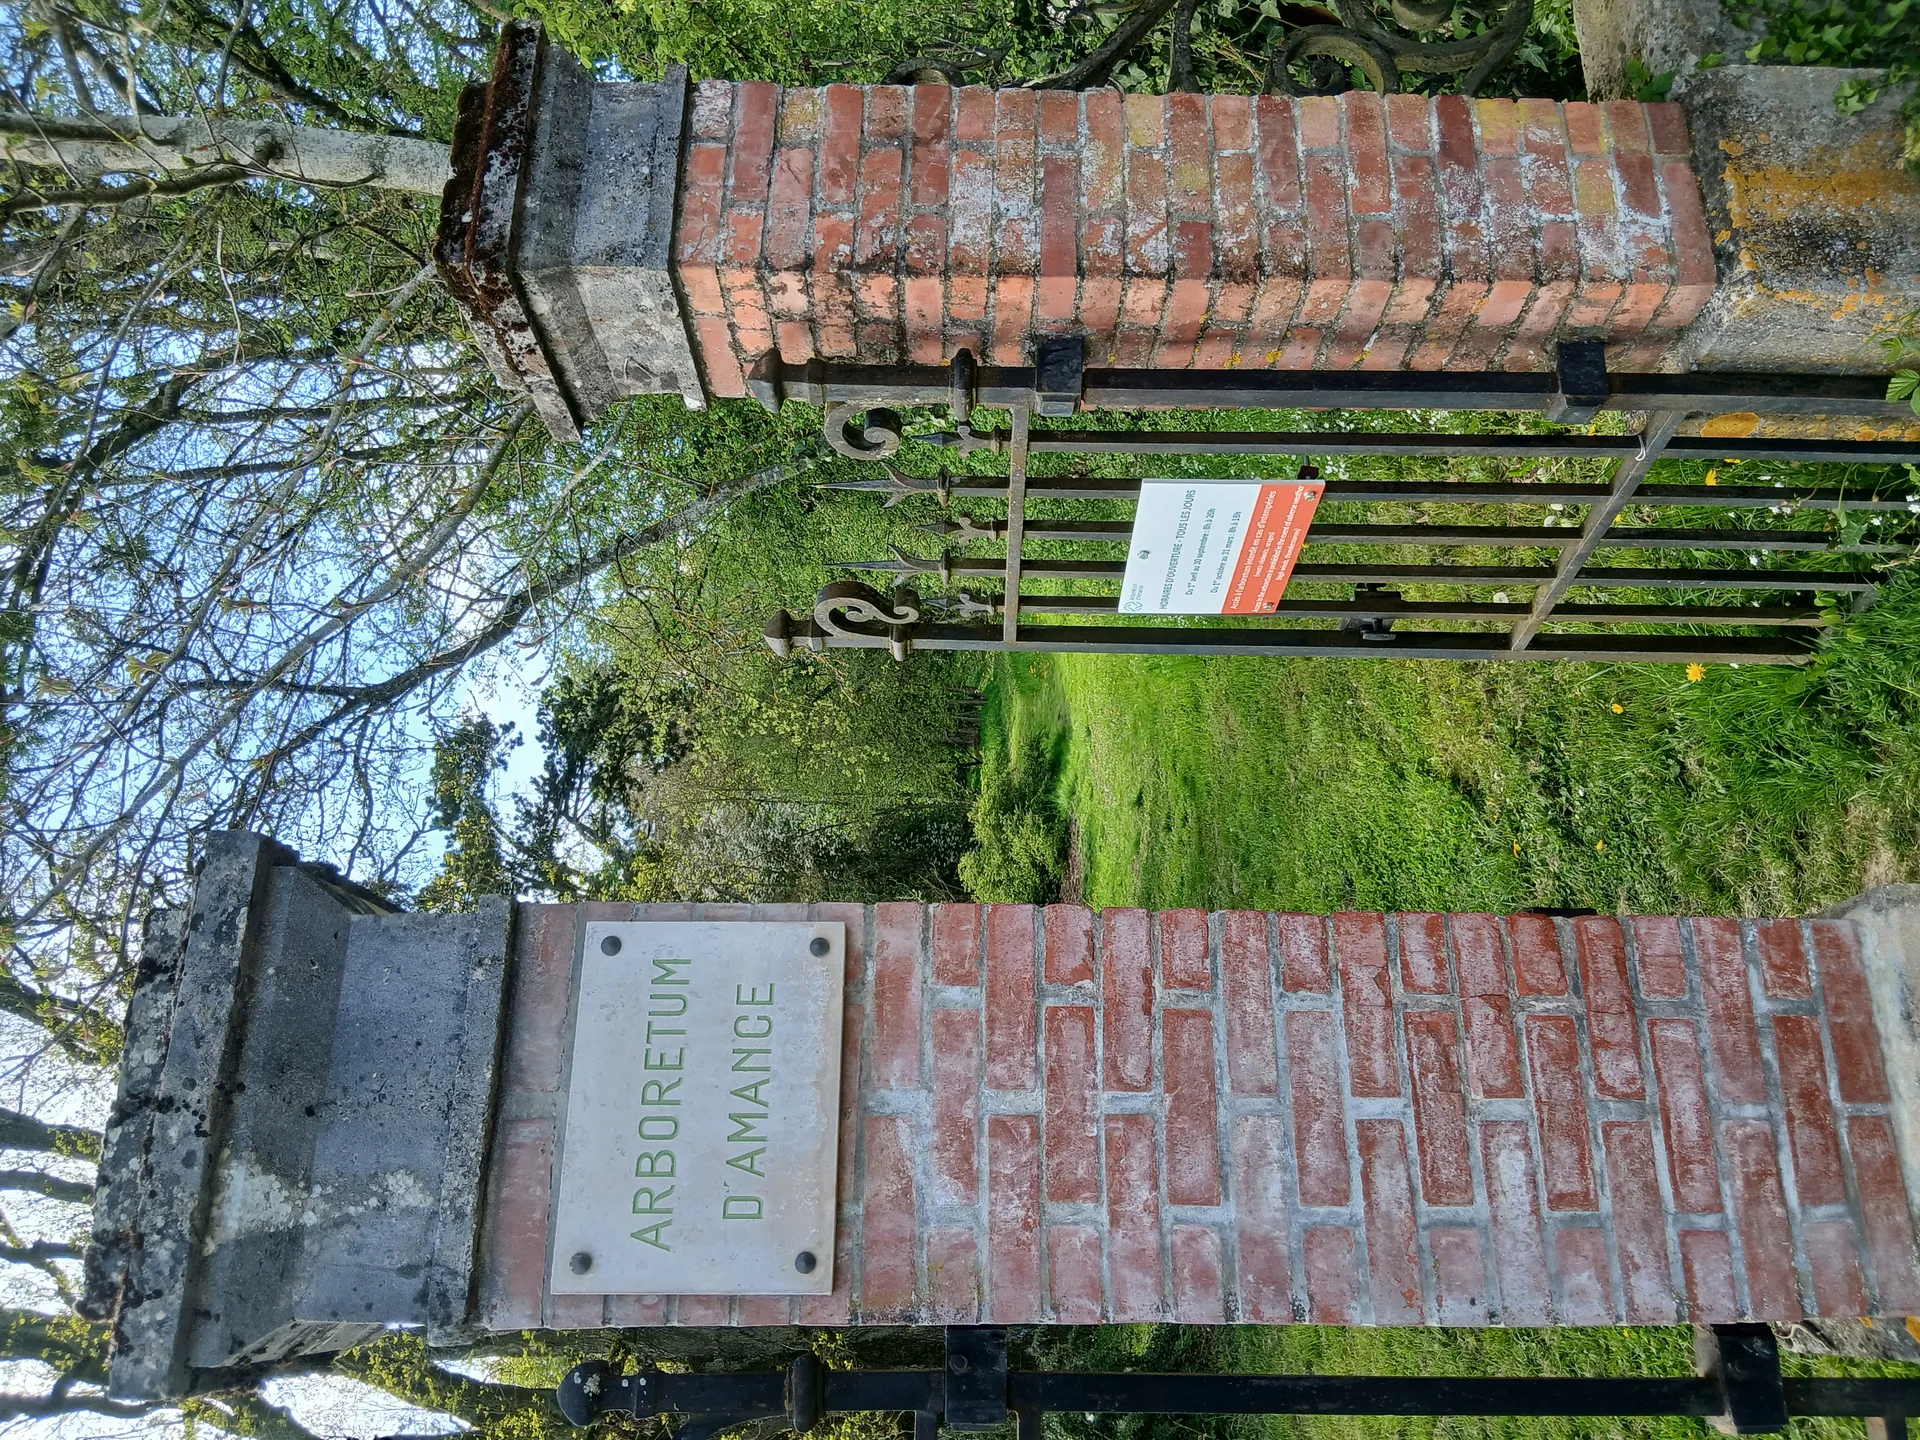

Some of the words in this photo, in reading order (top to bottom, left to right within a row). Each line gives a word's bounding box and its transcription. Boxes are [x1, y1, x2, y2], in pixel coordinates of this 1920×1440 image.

[1182, 489, 1196, 511] JOURS
[1257, 490, 1277, 529] d'intempéries
[1180, 511, 1191, 522] LES
[1175, 523, 1188, 539] TOUS
[1253, 538, 1261, 546] en
[1255, 529, 1264, 538] cas
[1190, 572, 1198, 582] avril
[1196, 533, 1209, 558] septembre
[1206, 508, 1216, 519] 20h
[1216, 562, 1226, 580] octobre
[1225, 536, 1234, 548] mars
[1231, 511, 1242, 521] 18h
[1244, 546, 1258, 565] interdit
[1252, 602, 1262, 613] Access
[1280, 527, 1290, 538] event
[1285, 504, 1298, 521] adverse
[1292, 485, 1304, 505] weather
[1165, 543, 1183, 582] D'OUVERTURE
[1234, 565, 1252, 593] l'arboretum
[1159, 583, 1173, 610] HORAIRES
[1229, 596, 1241, 609] Accès
[630, 957, 692, 1252] ARBORETUM
[722, 982, 775, 1221] D'AMANCE
